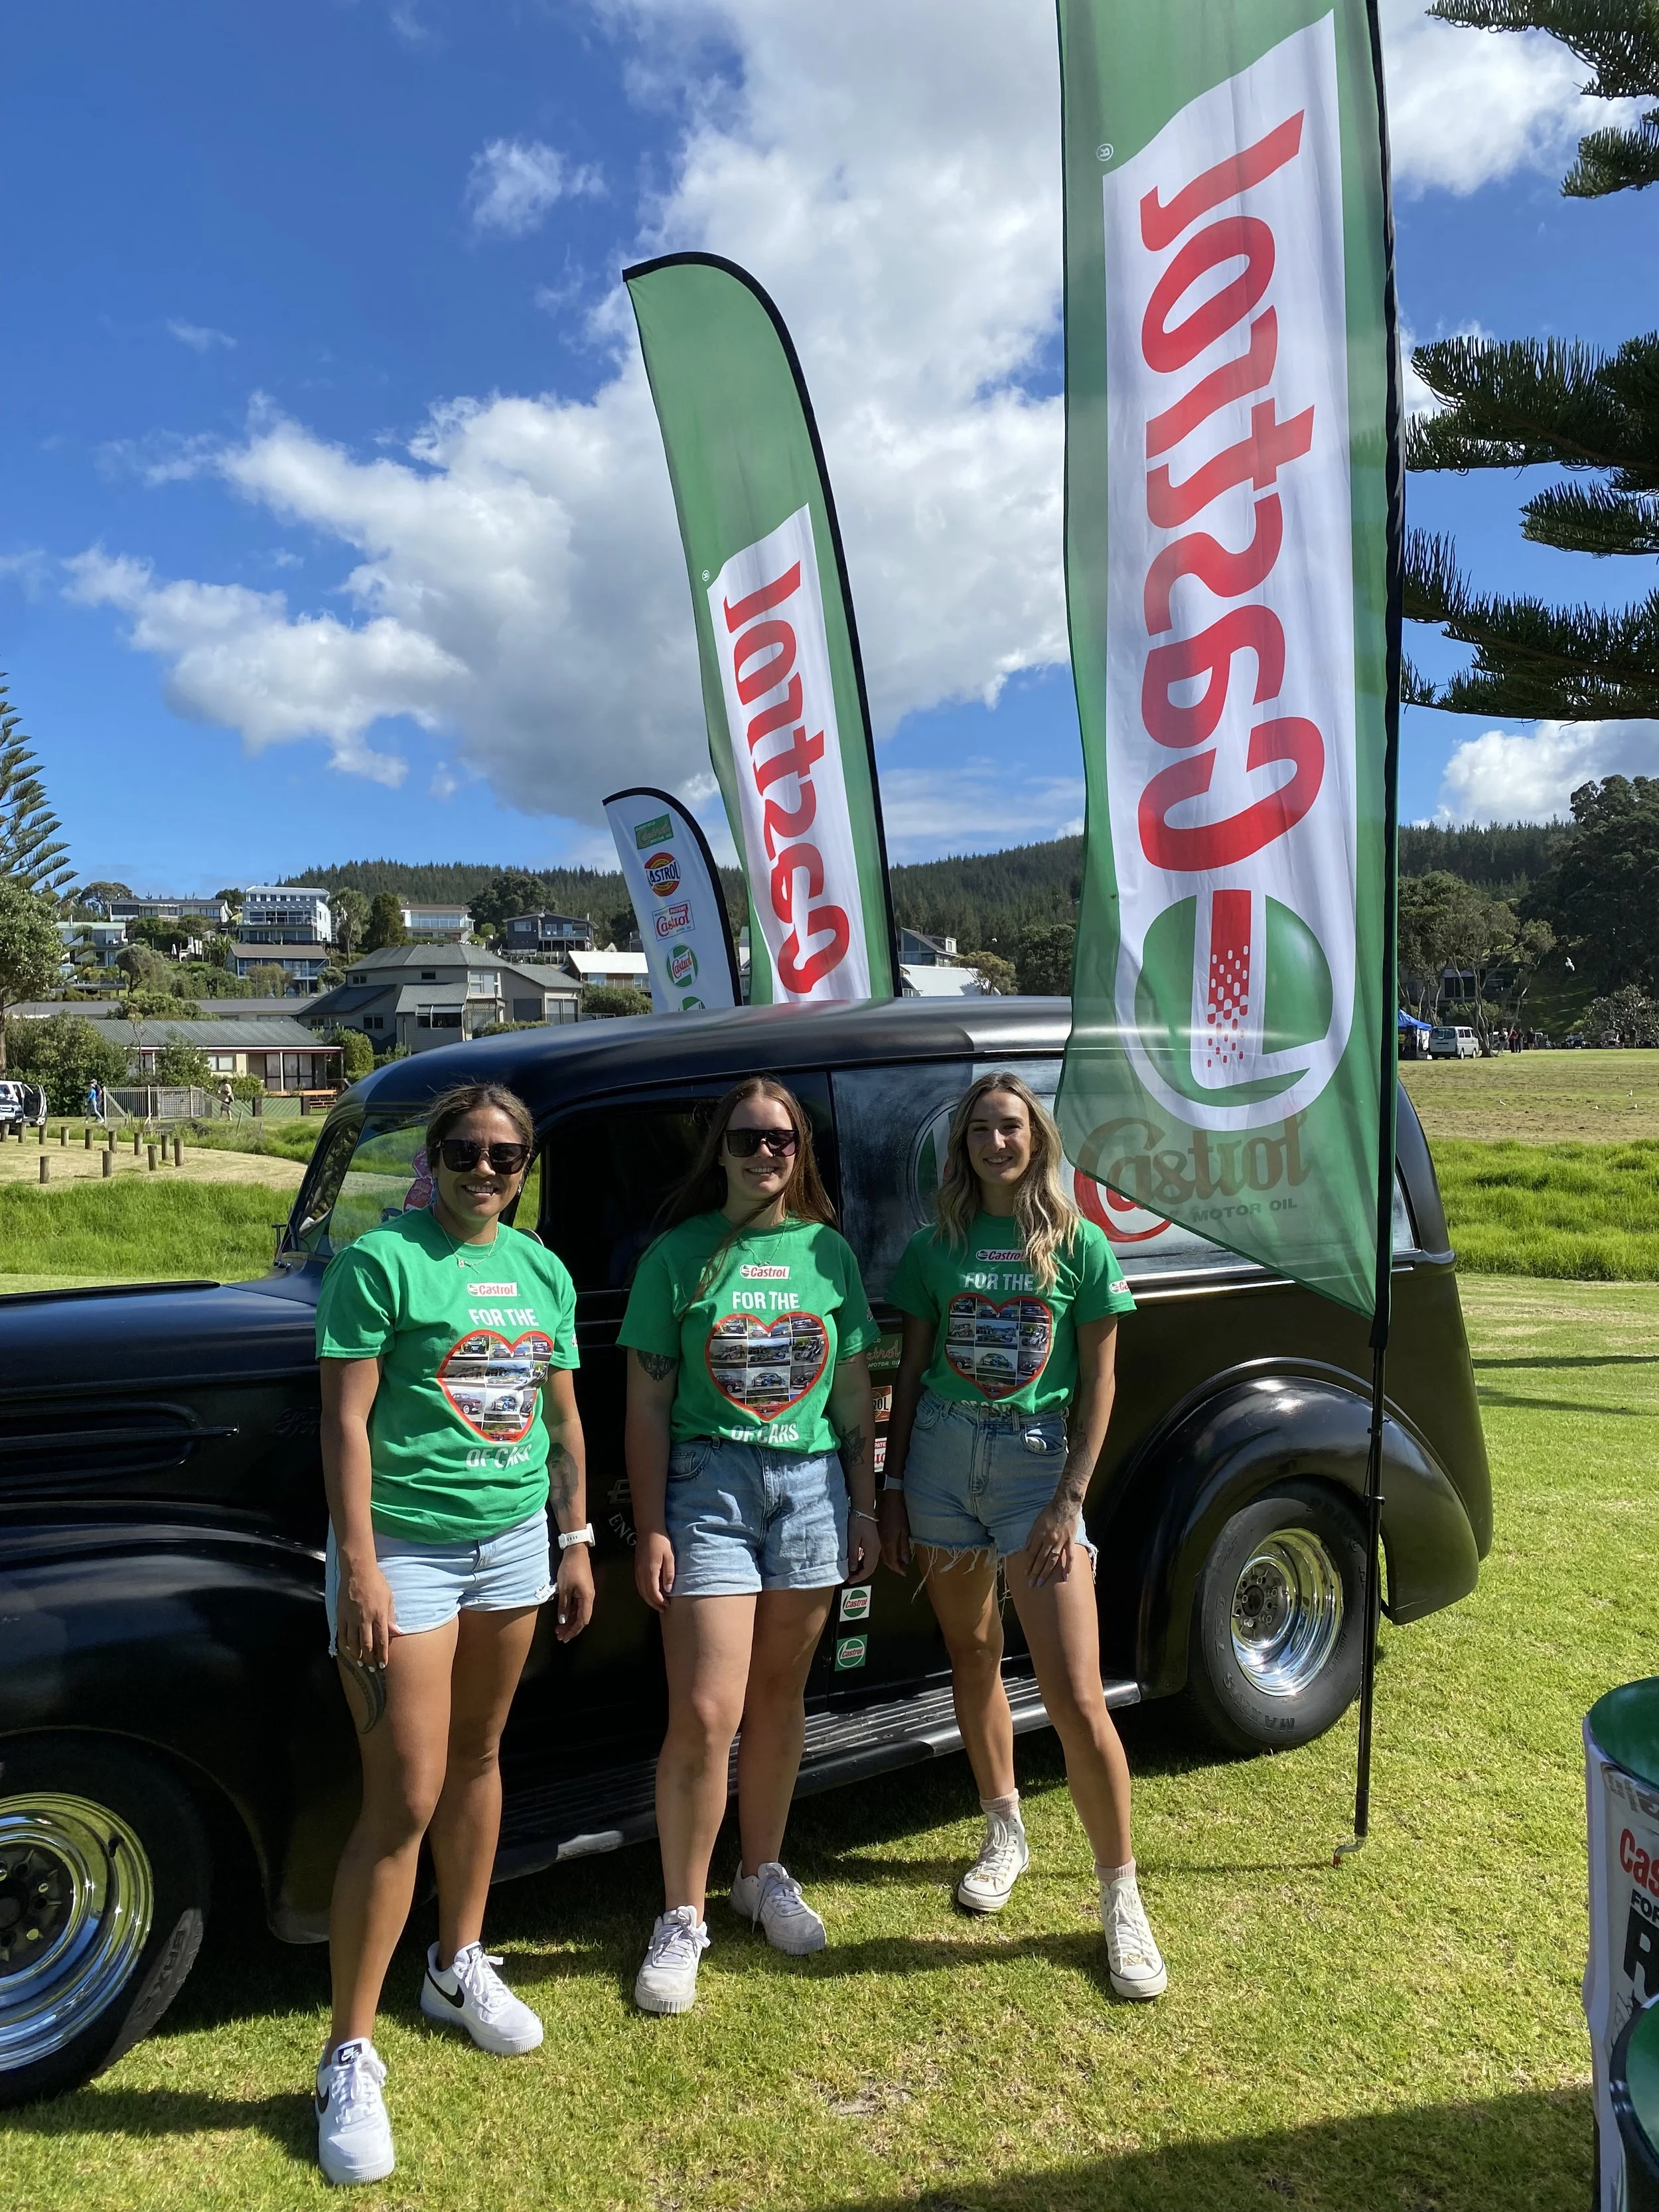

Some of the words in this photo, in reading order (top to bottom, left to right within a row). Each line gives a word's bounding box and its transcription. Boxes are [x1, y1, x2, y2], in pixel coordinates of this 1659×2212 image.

[656, 905, 690, 937] Castrol
[1074, 1103, 1313, 1242] Castrol
[1193, 1203, 1262, 1222] MOTOR
[1269, 1198, 1298, 1212] OIL
[751, 1267, 786, 1278] Castrol
[965, 1272, 999, 1290] FOR
[1003, 1274, 1035, 1291] THE
[478, 1285, 514, 1295] Castrol
[732, 1291, 767, 1309] FOR
[768, 1291, 800, 1310] THE
[467, 1308, 507, 1326] FOR
[503, 1308, 540, 1326] THE
[866, 1340, 901, 1361] strol
[731, 1425, 755, 1442] OF
[757, 1423, 800, 1444] CARS
[466, 1449, 493, 1467] OF
[845, 1598, 868, 1609] Castrol
[841, 1649, 864, 1658] Castrol
